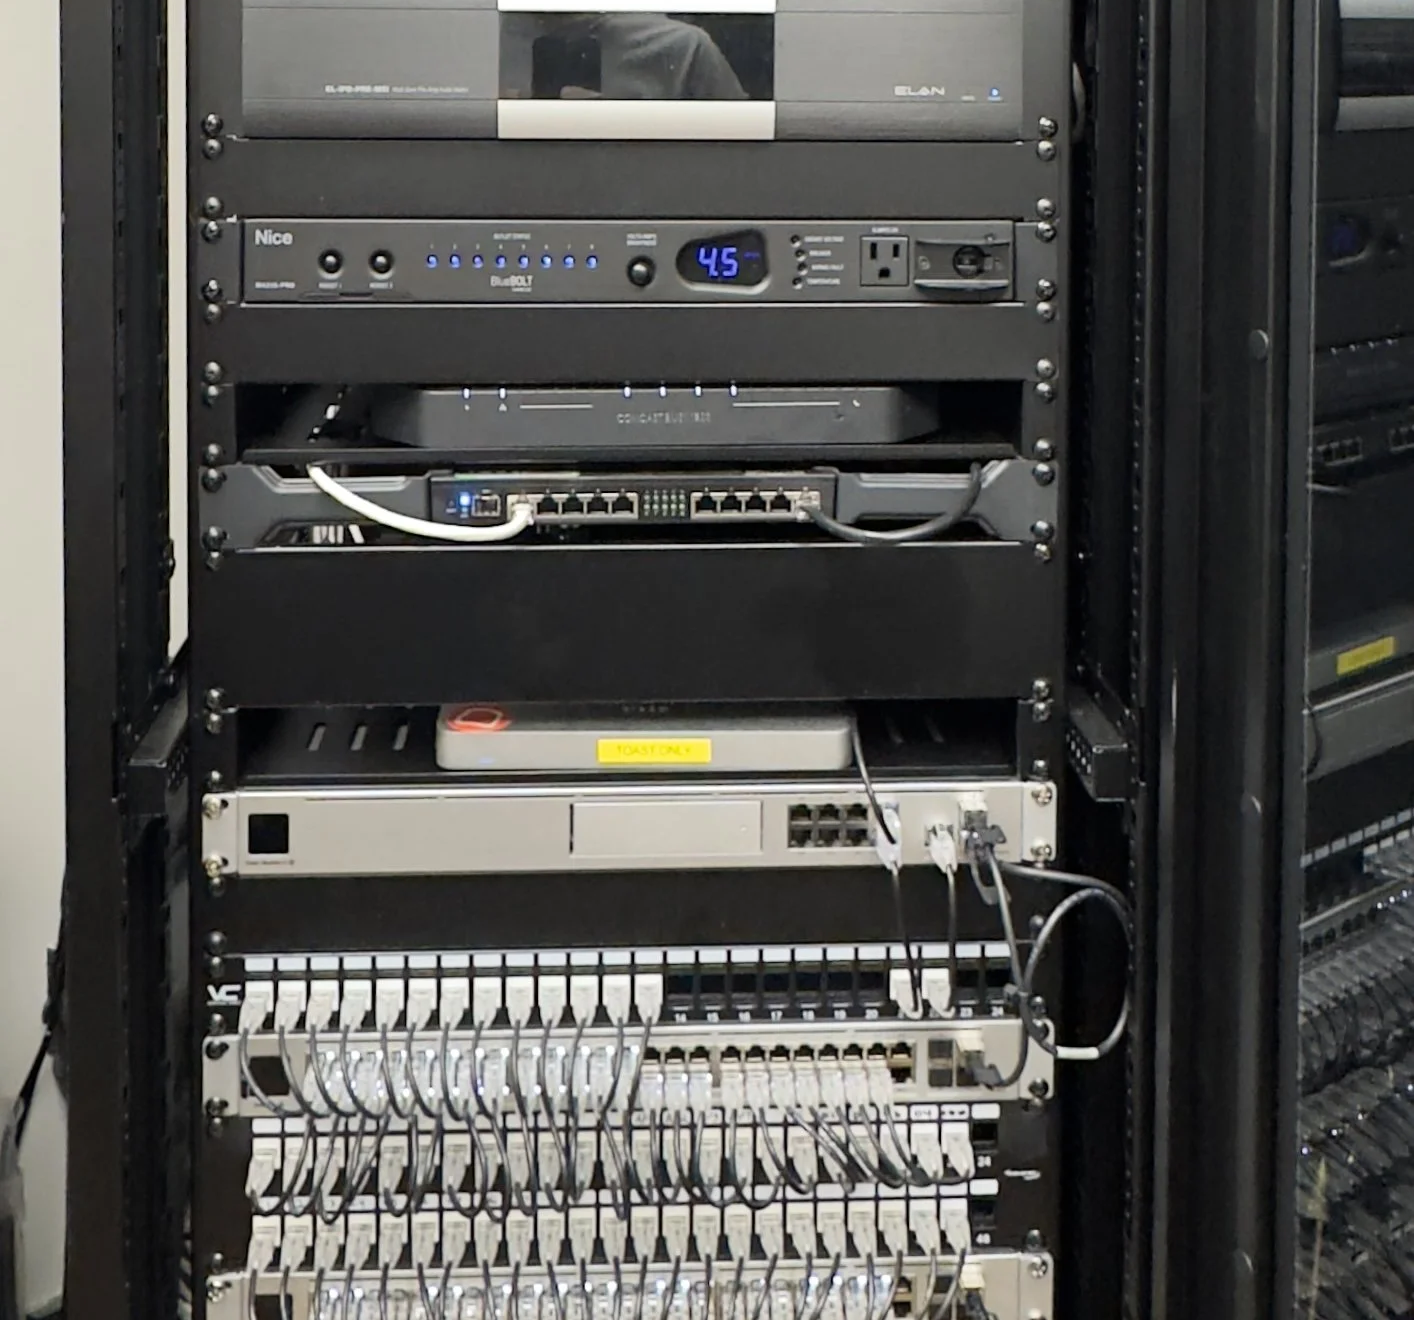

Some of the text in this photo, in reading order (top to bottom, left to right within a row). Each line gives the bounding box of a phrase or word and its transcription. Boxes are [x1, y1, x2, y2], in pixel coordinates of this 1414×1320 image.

[894, 85, 945, 96] ELAN
[254, 229, 293, 245] Nice
[699, 247, 738, 277] 4.5
[490, 275, 533, 287] BlueBOLT
[617, 745, 655, 756] TOAST
[771, 1011, 782, 1021] 17
